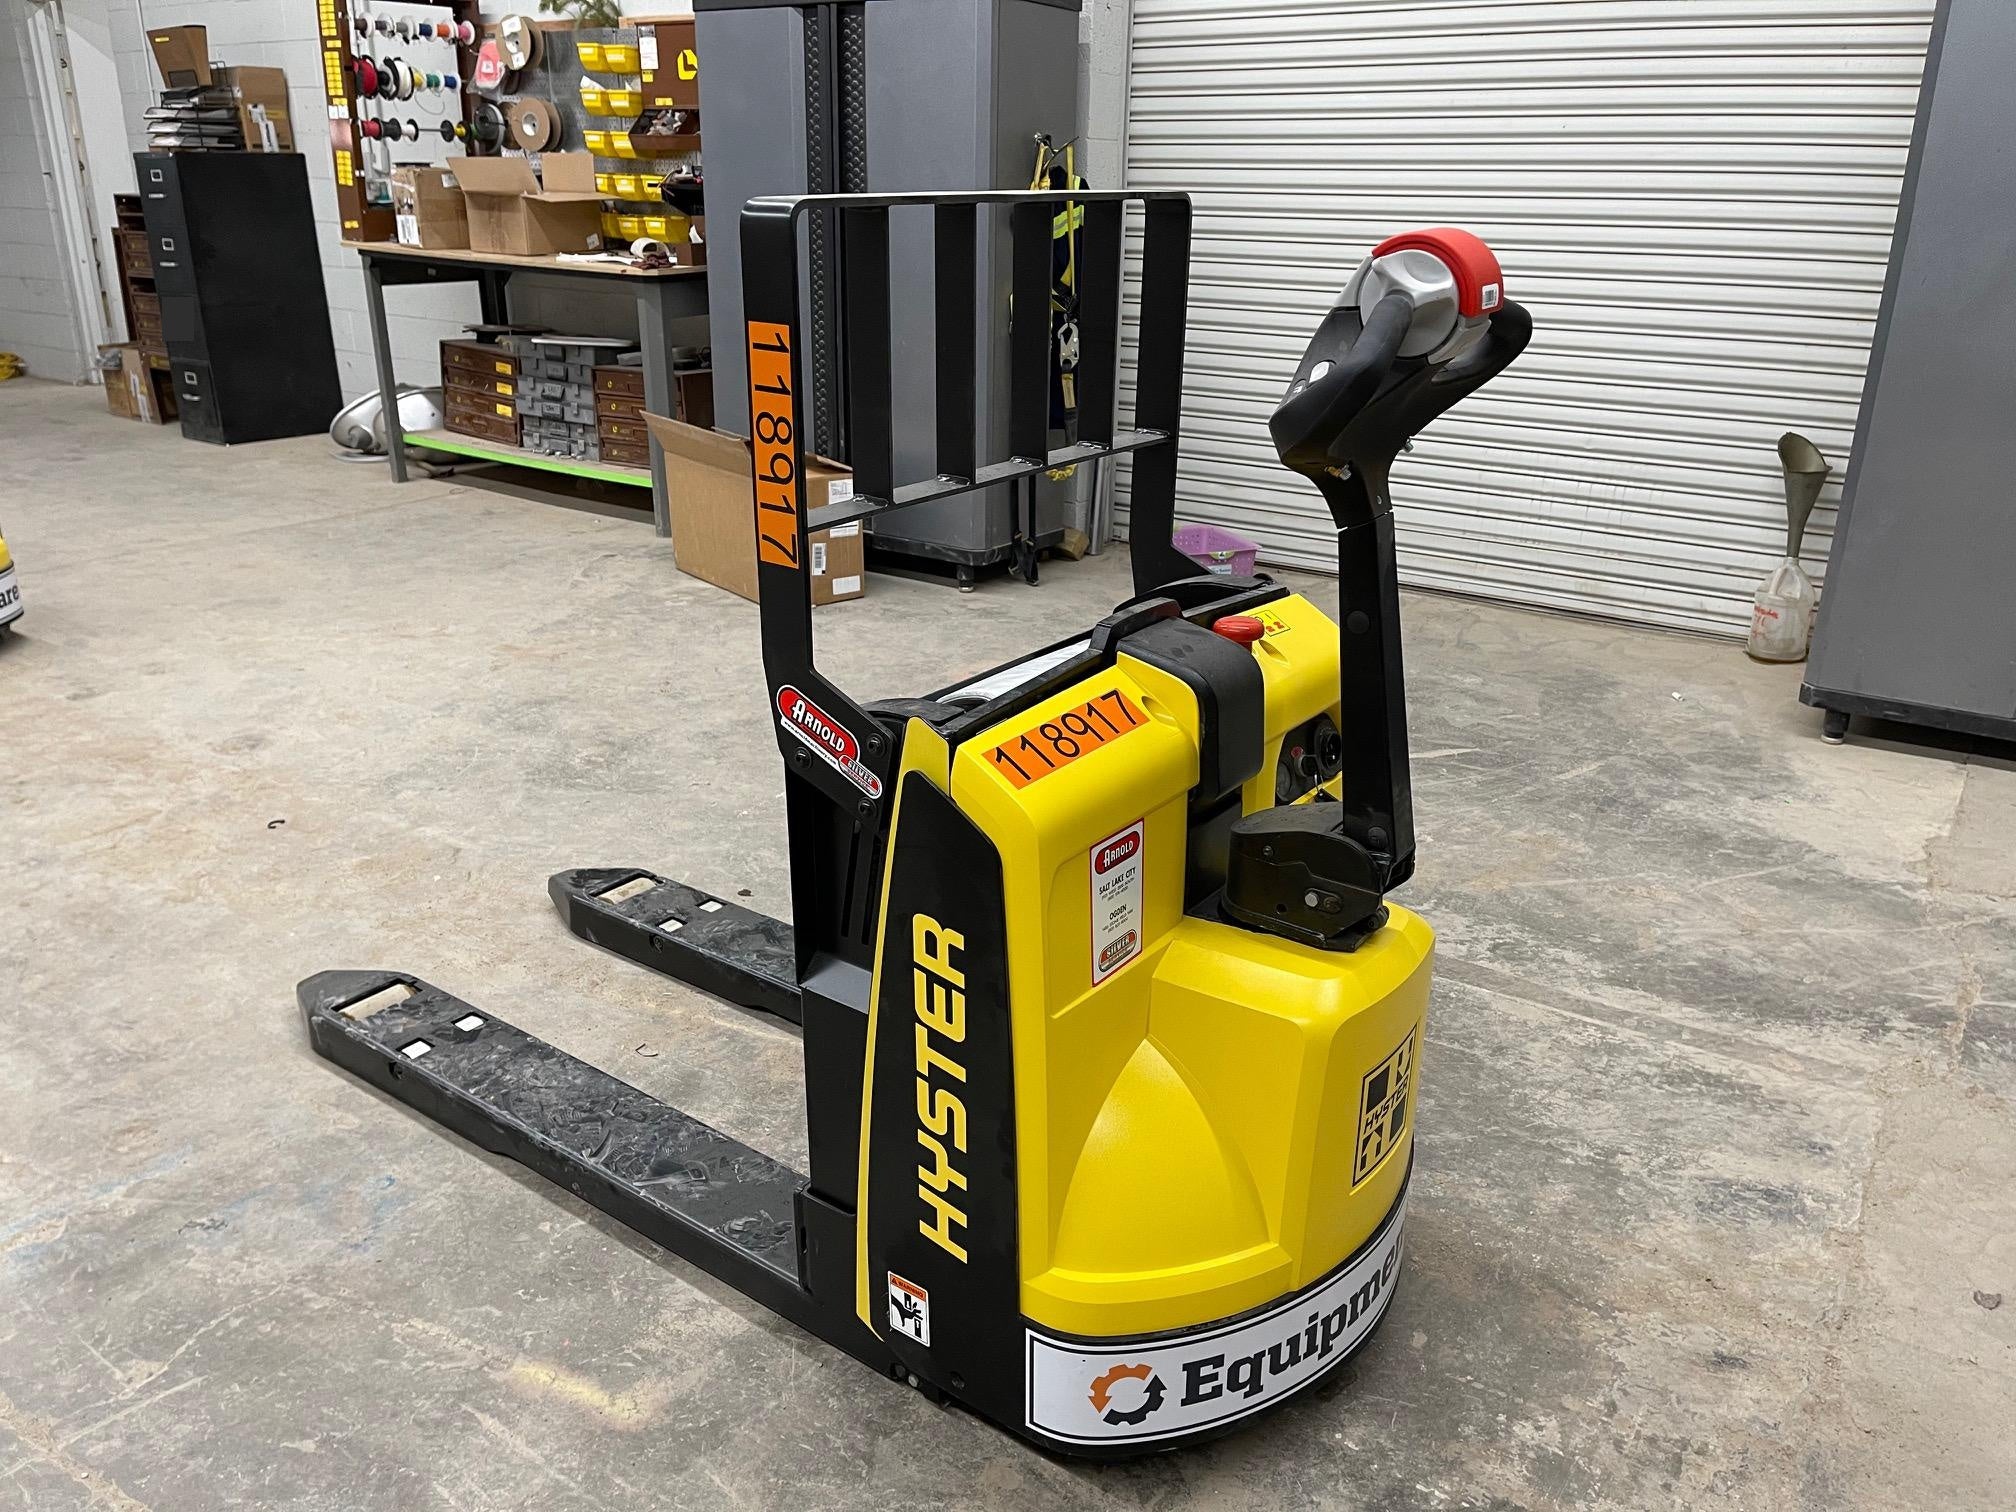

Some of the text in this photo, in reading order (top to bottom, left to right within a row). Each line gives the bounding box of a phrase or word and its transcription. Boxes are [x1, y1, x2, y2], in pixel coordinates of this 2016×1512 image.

[751, 332, 798, 565] 118917
[791, 699, 846, 753] ARNOLD
[996, 689, 1137, 781] 118917
[1098, 881, 1111, 896] SALT
[1111, 873, 1125, 887] LAKE
[1125, 866, 1136, 879] CITY
[1103, 840, 1134, 868] ARNOLD
[1109, 903, 1127, 920] OGDEN
[912, 912, 968, 1265] HYSTER
[1363, 1074, 1409, 1134] HYSTER
